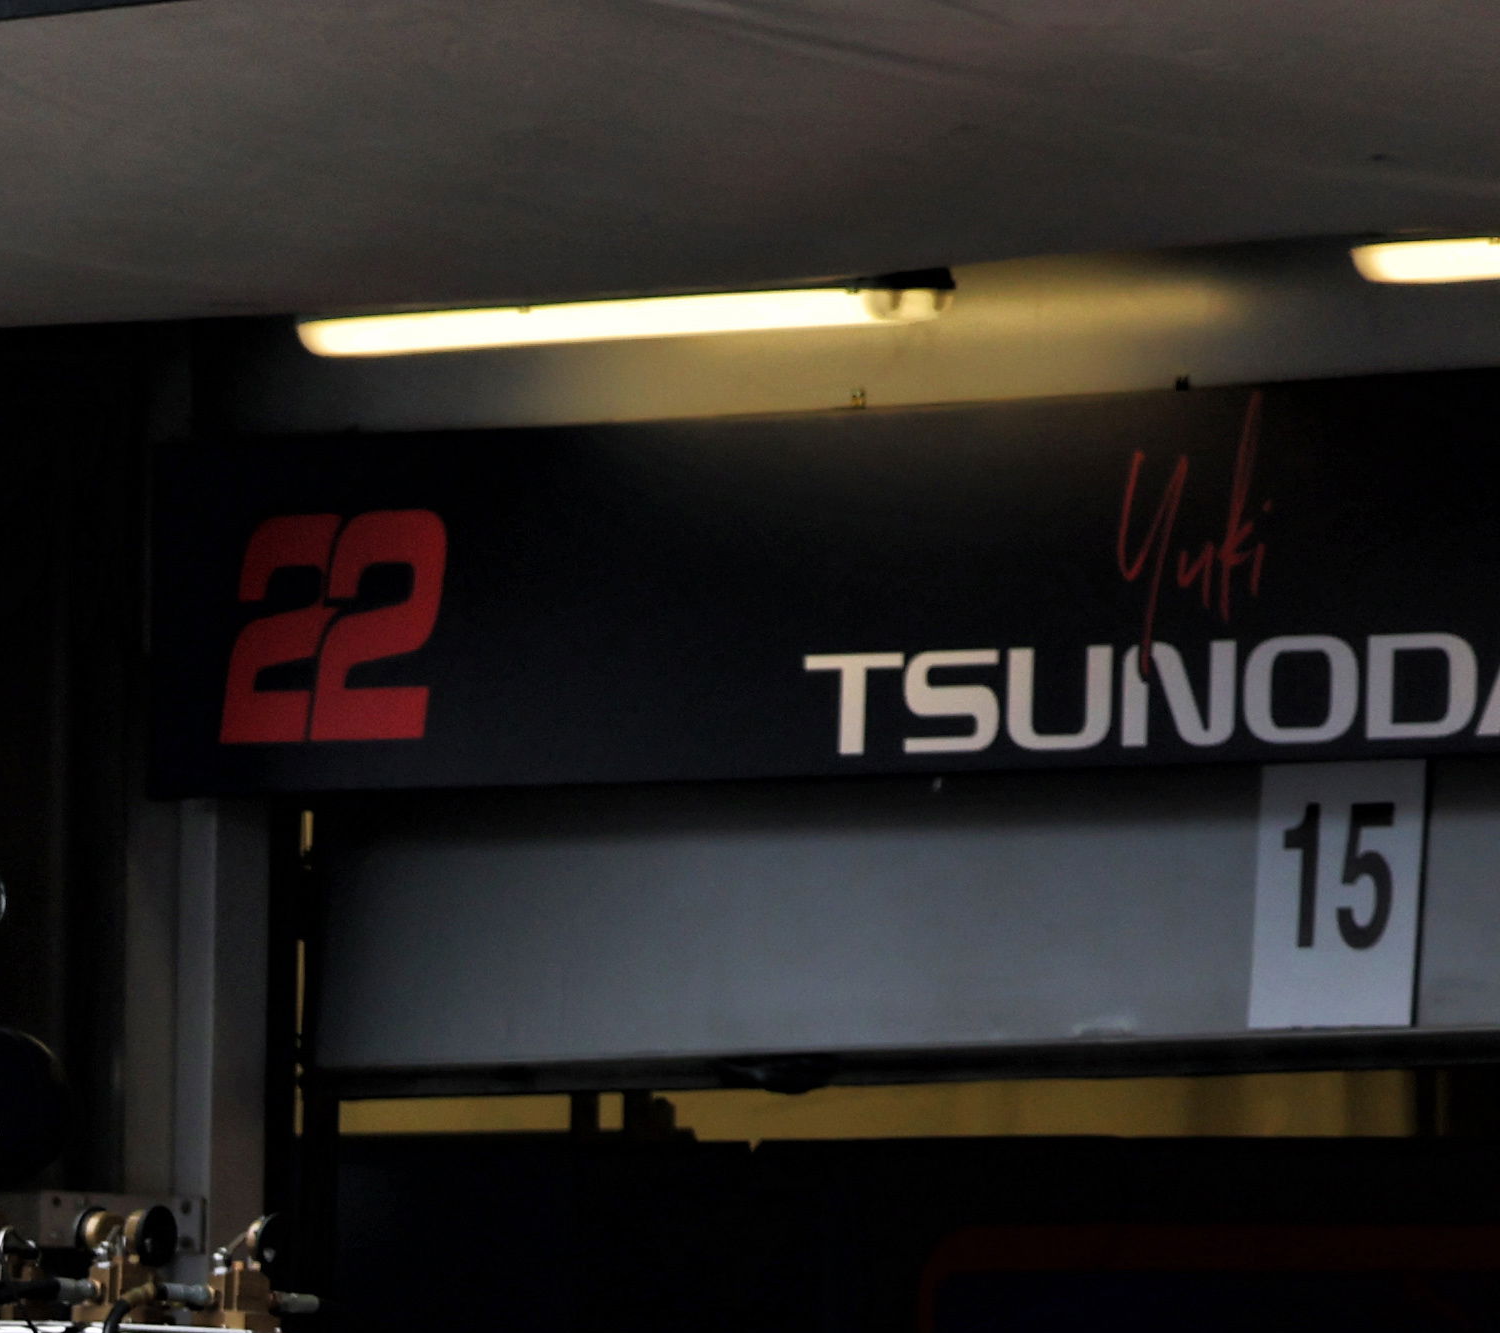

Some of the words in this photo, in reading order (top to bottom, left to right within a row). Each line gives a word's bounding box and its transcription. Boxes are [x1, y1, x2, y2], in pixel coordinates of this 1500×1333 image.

[218, 509, 448, 743] 22
[803, 632, 1500, 756] TSUNOD
[1281, 800, 1396, 952] 15
